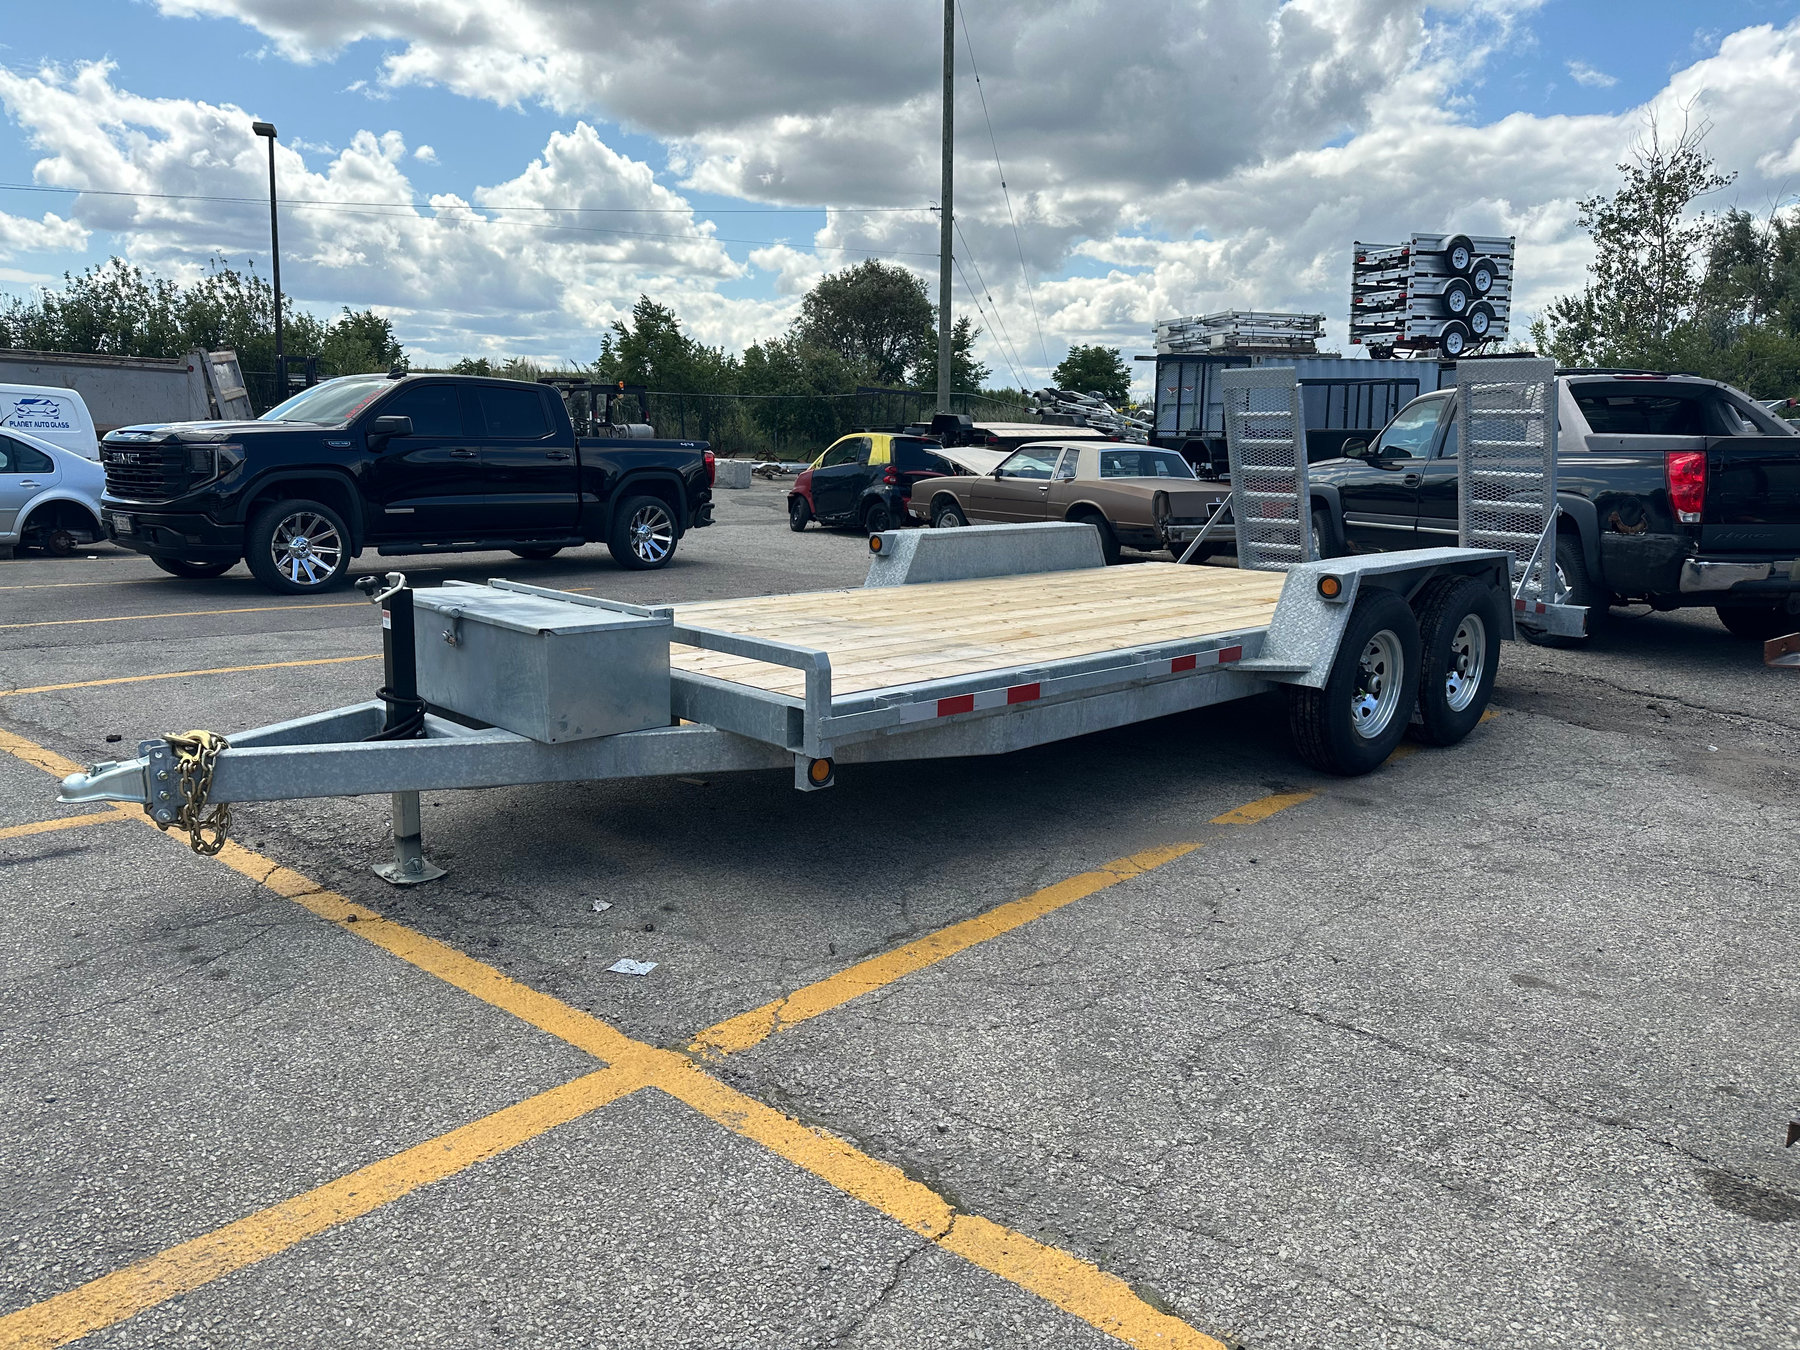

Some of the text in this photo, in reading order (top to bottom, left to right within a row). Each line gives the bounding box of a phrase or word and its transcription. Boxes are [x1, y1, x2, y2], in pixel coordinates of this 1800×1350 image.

[9, 420, 32, 428] PLANET
[50, 421, 70, 429] GLASS
[112, 452, 140, 465] GMC
